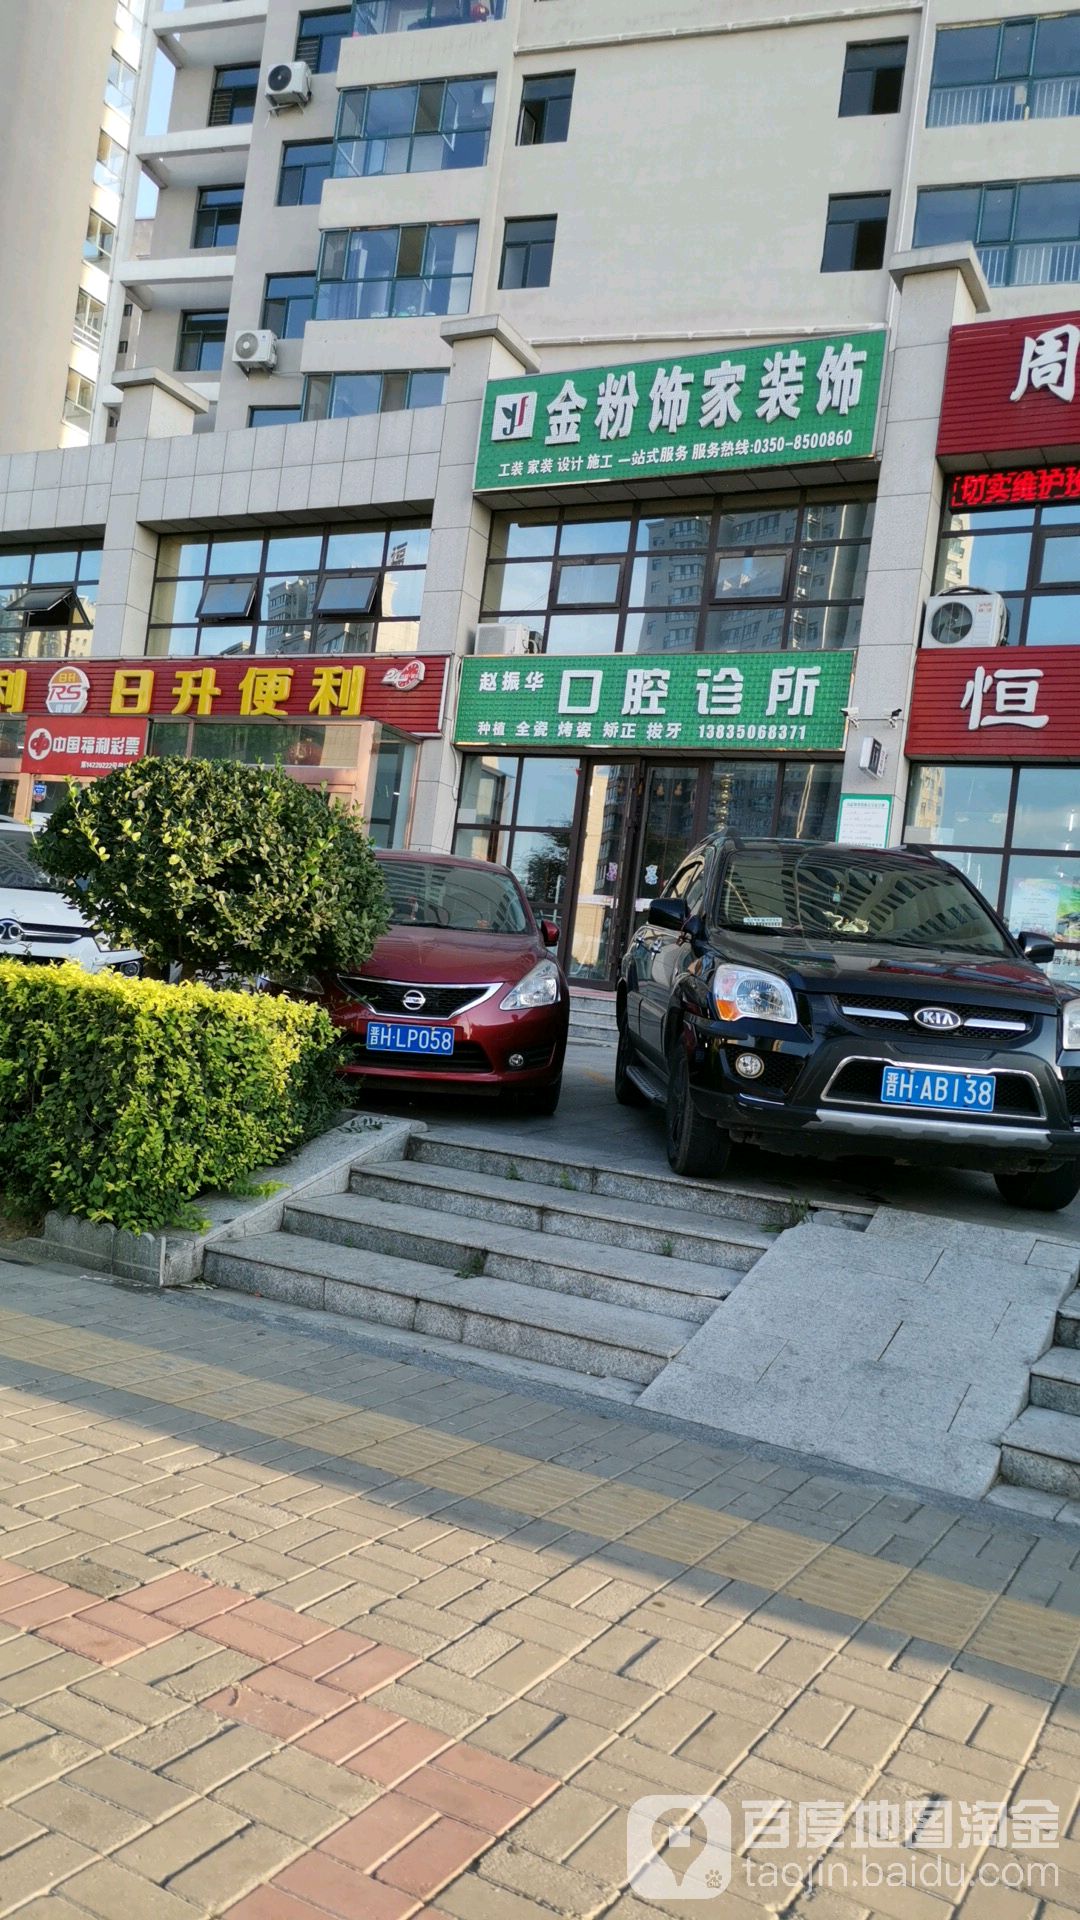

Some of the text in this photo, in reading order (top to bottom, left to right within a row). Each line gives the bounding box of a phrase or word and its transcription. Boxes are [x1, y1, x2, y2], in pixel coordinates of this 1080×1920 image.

[1010, 324, 1080, 403] 周
[544, 343, 867, 445] 金粉饰家装饰
[498, 461, 522, 477] 工装
[527, 458, 553, 474] 家装
[557, 455, 583, 472] 设计
[586, 454, 613, 470] 施工
[618, 445, 688, 466] 一站式服务
[109, 665, 366, 716] 日升便利
[479, 671, 545, 692] 赵振华
[558, 666, 822, 716] 口腔诊所
[960, 666, 1049, 731] 恒
[52, 736, 140, 755] 中国福利彩票
[478, 721, 807, 741] 种植 全瓷 烤瓷 矫正 拔牙 13835068371
[922, 1011, 954, 1025] KIA
